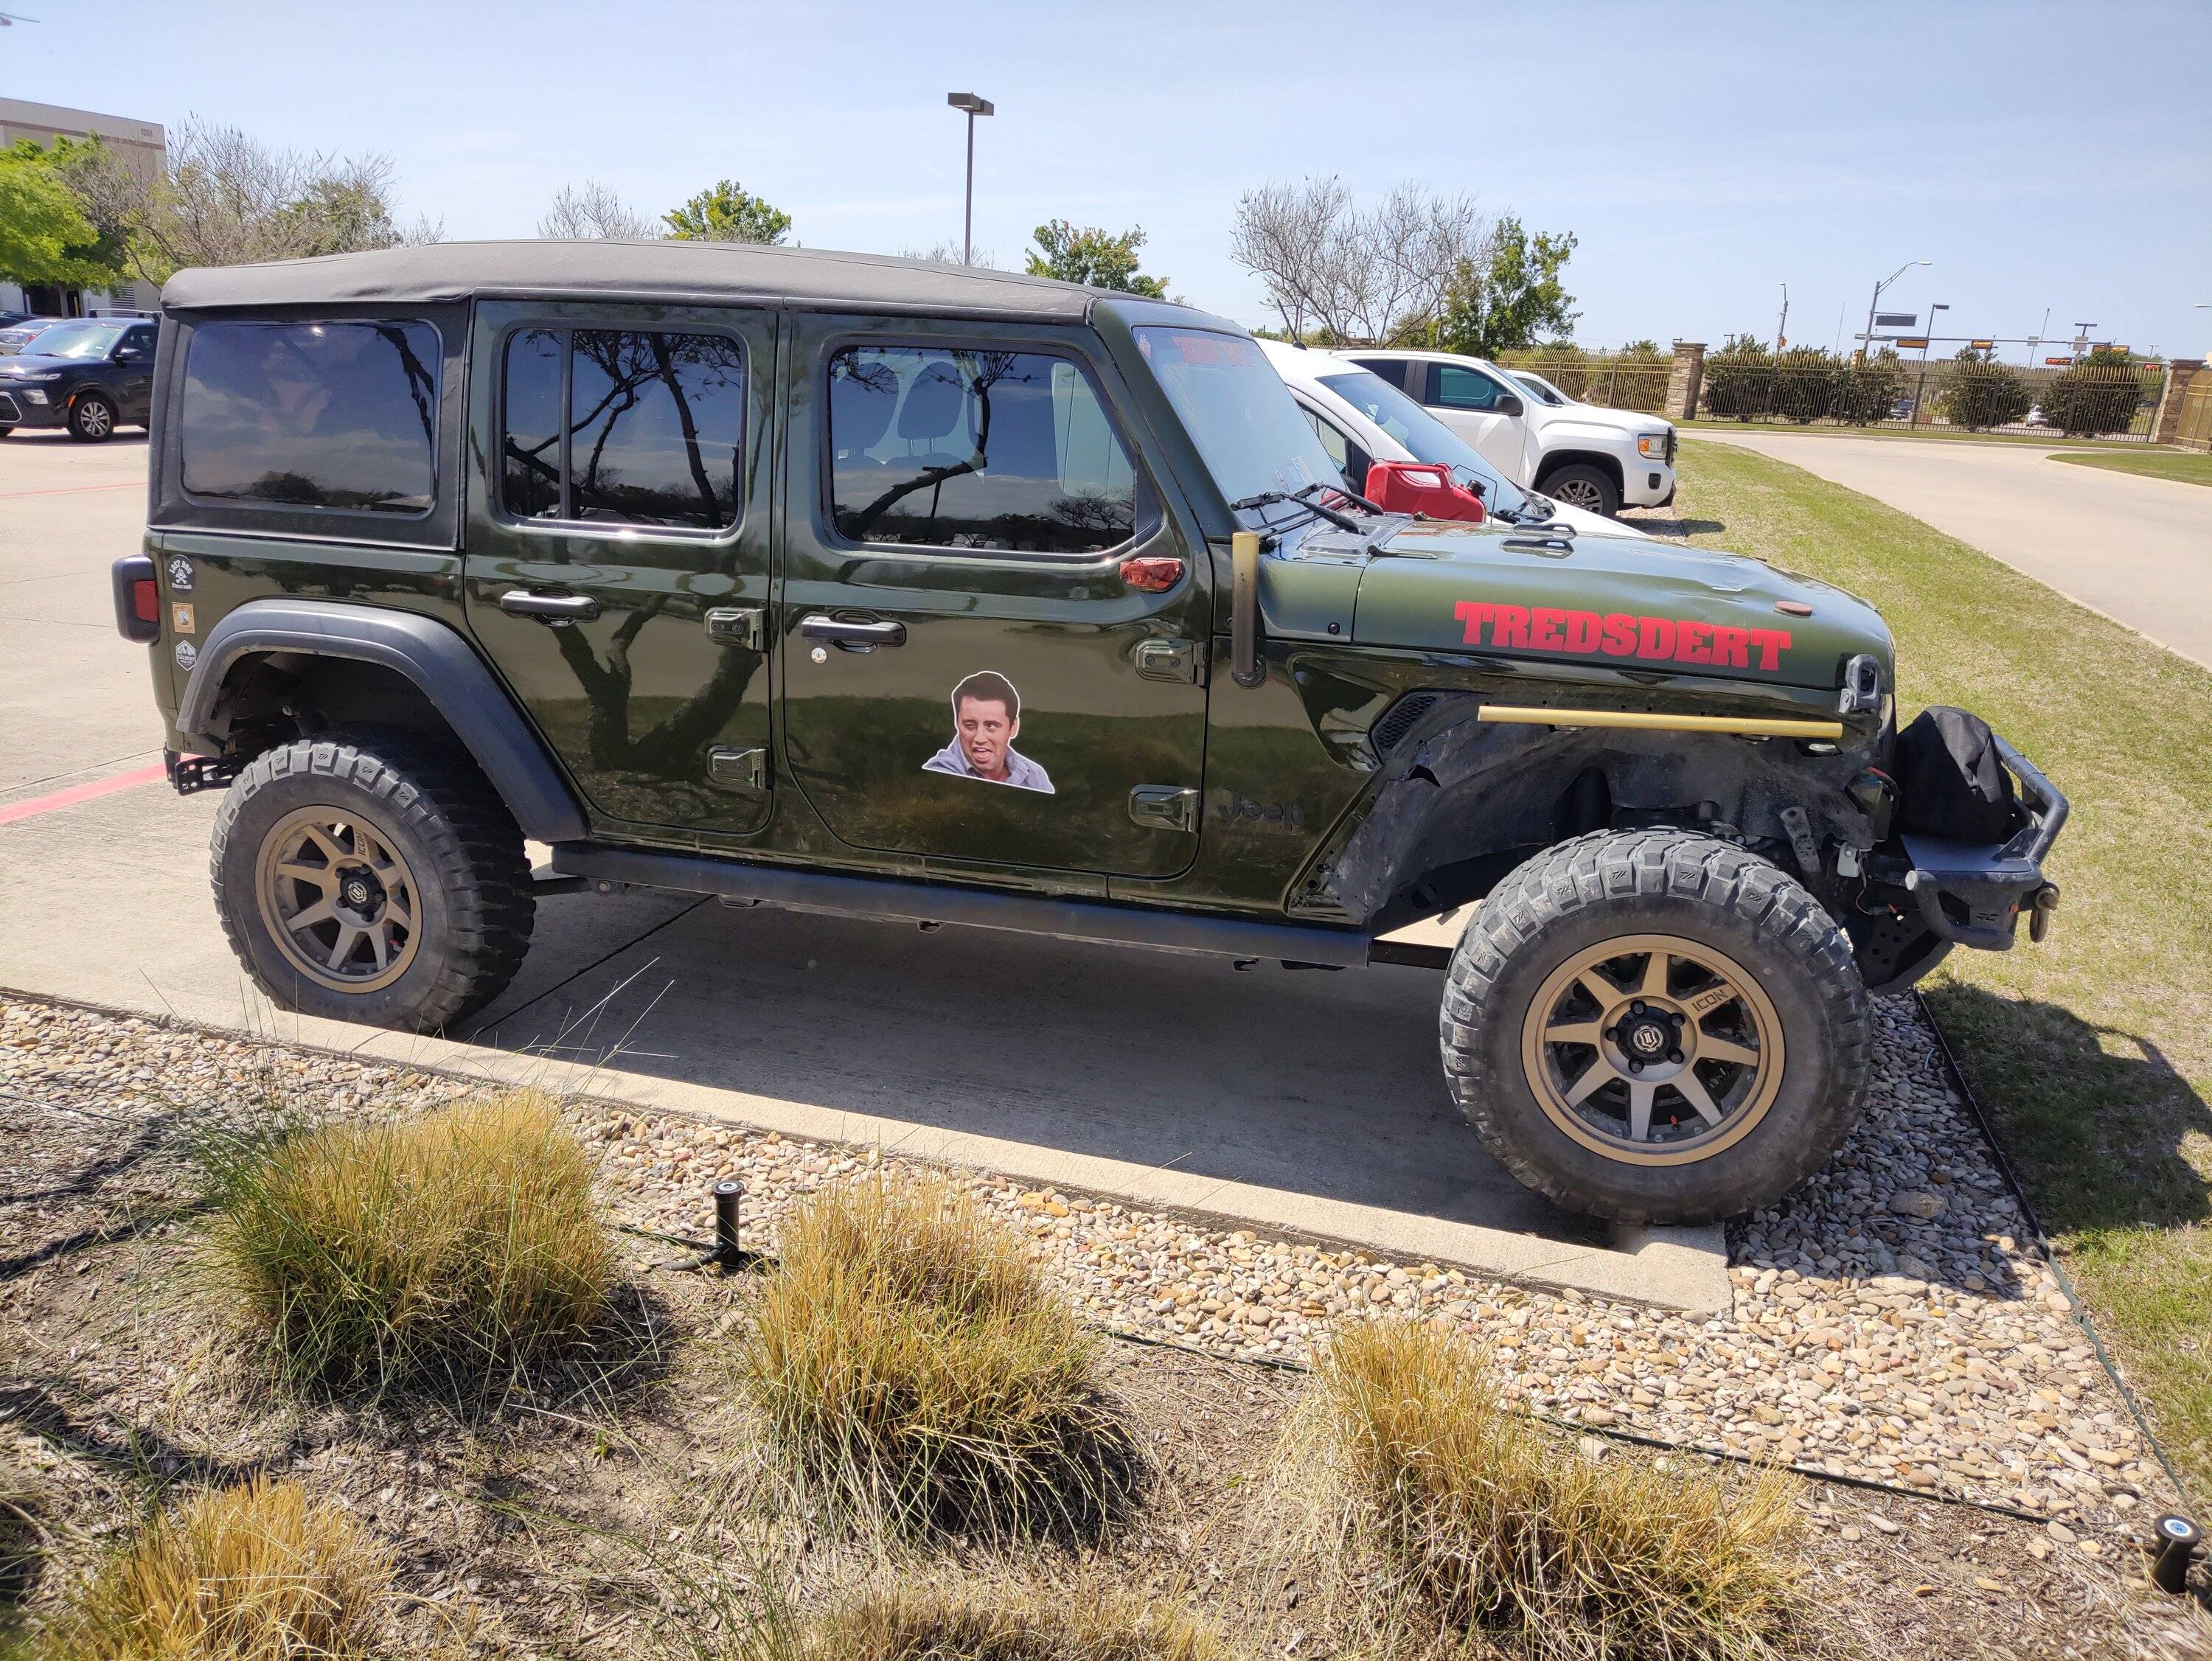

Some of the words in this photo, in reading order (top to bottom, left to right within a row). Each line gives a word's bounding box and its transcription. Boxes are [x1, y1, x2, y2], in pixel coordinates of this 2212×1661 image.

[1454, 601, 1792, 672] TREDSDERT
[1217, 790, 1306, 831] Jeep
[1691, 989, 1729, 1011] ICON
